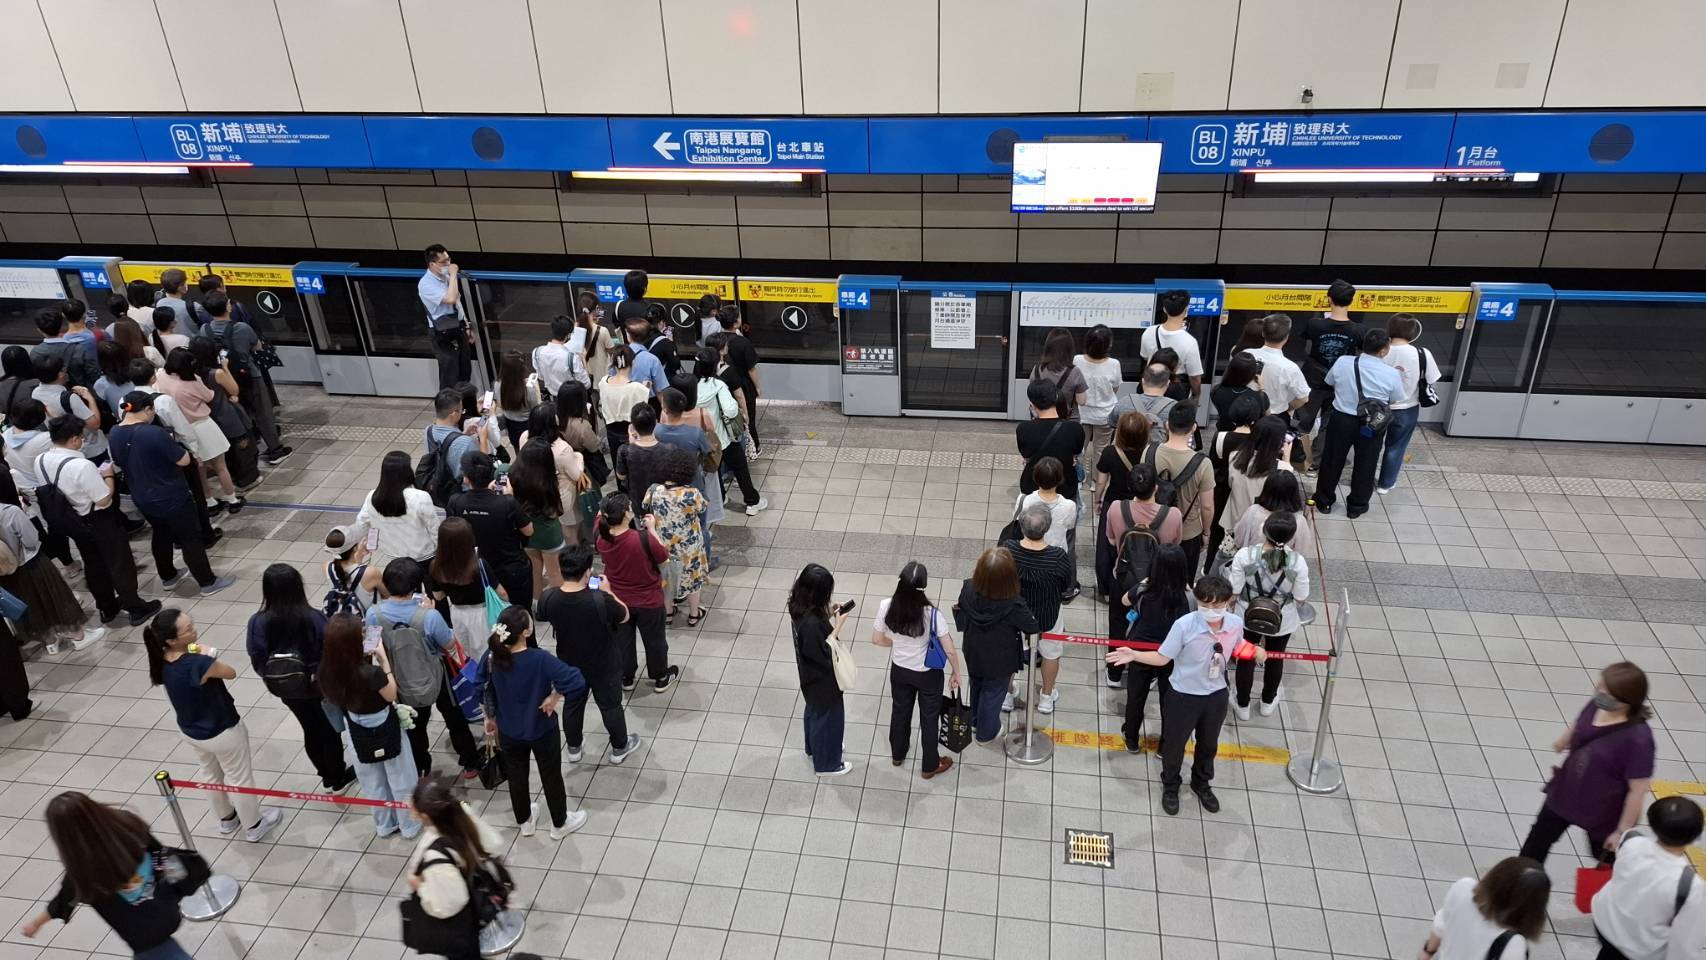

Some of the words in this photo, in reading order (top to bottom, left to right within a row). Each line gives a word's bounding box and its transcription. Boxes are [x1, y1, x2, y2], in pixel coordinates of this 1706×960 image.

[201, 122, 244, 143] 新埔
[245, 123, 288, 134] 致理科大
[1233, 122, 1288, 146] 新埔
[1293, 122, 1349, 135] 致理科大
[176, 129, 195, 142] BL
[689, 132, 765, 146] 南港展覽館
[1200, 130, 1221, 144] BL
[181, 143, 198, 155] 08
[206, 145, 233, 153] XINPU
[695, 146, 720, 155] Taipei
[722, 146, 762, 155] Nangang
[776, 142, 824, 153] 台北車站
[1198, 146, 1218, 159] 08
[1231, 148, 1265, 157] XINPU
[1469, 146, 1498, 159] 月台
[1456, 146, 1467, 166] 1
[98, 273, 107, 285] 4
[312, 278, 322, 290] 4
[615, 286, 625, 299] 4
[857, 292, 868, 305] 4
[1206, 298, 1219, 312] 4
[1500, 302, 1514, 317] 4
